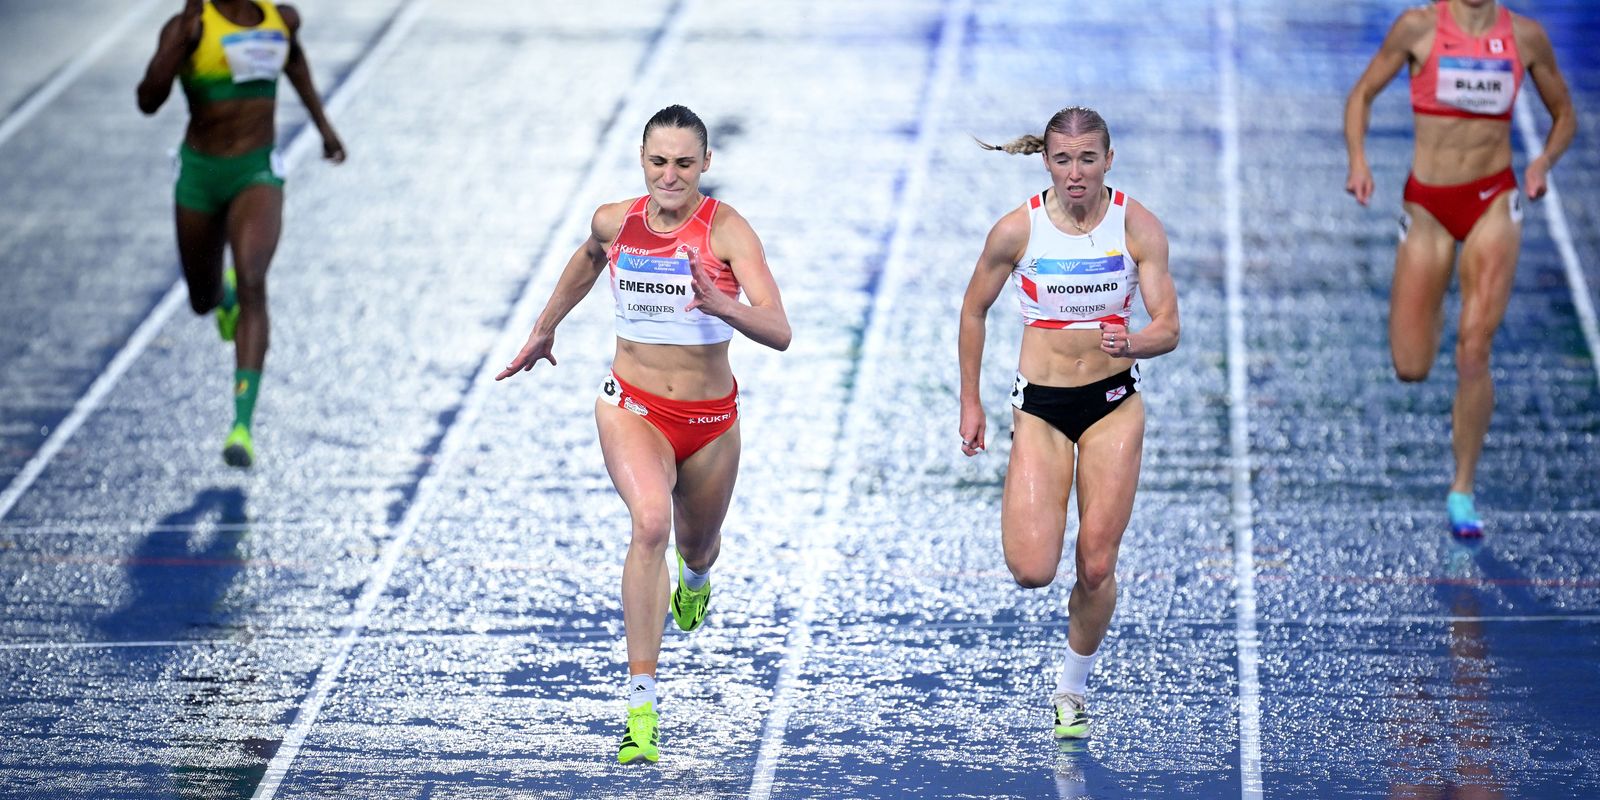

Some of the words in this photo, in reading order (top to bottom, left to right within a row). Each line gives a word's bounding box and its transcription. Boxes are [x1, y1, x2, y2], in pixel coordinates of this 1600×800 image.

[1456, 80, 1502, 92] BLAIR
[619, 279, 686, 296] EMERSON
[1047, 282, 1118, 295] WOODWARD
[627, 303, 675, 314] LONGINES
[1060, 303, 1106, 314] LONGINES
[697, 412, 731, 425] KUKRI
